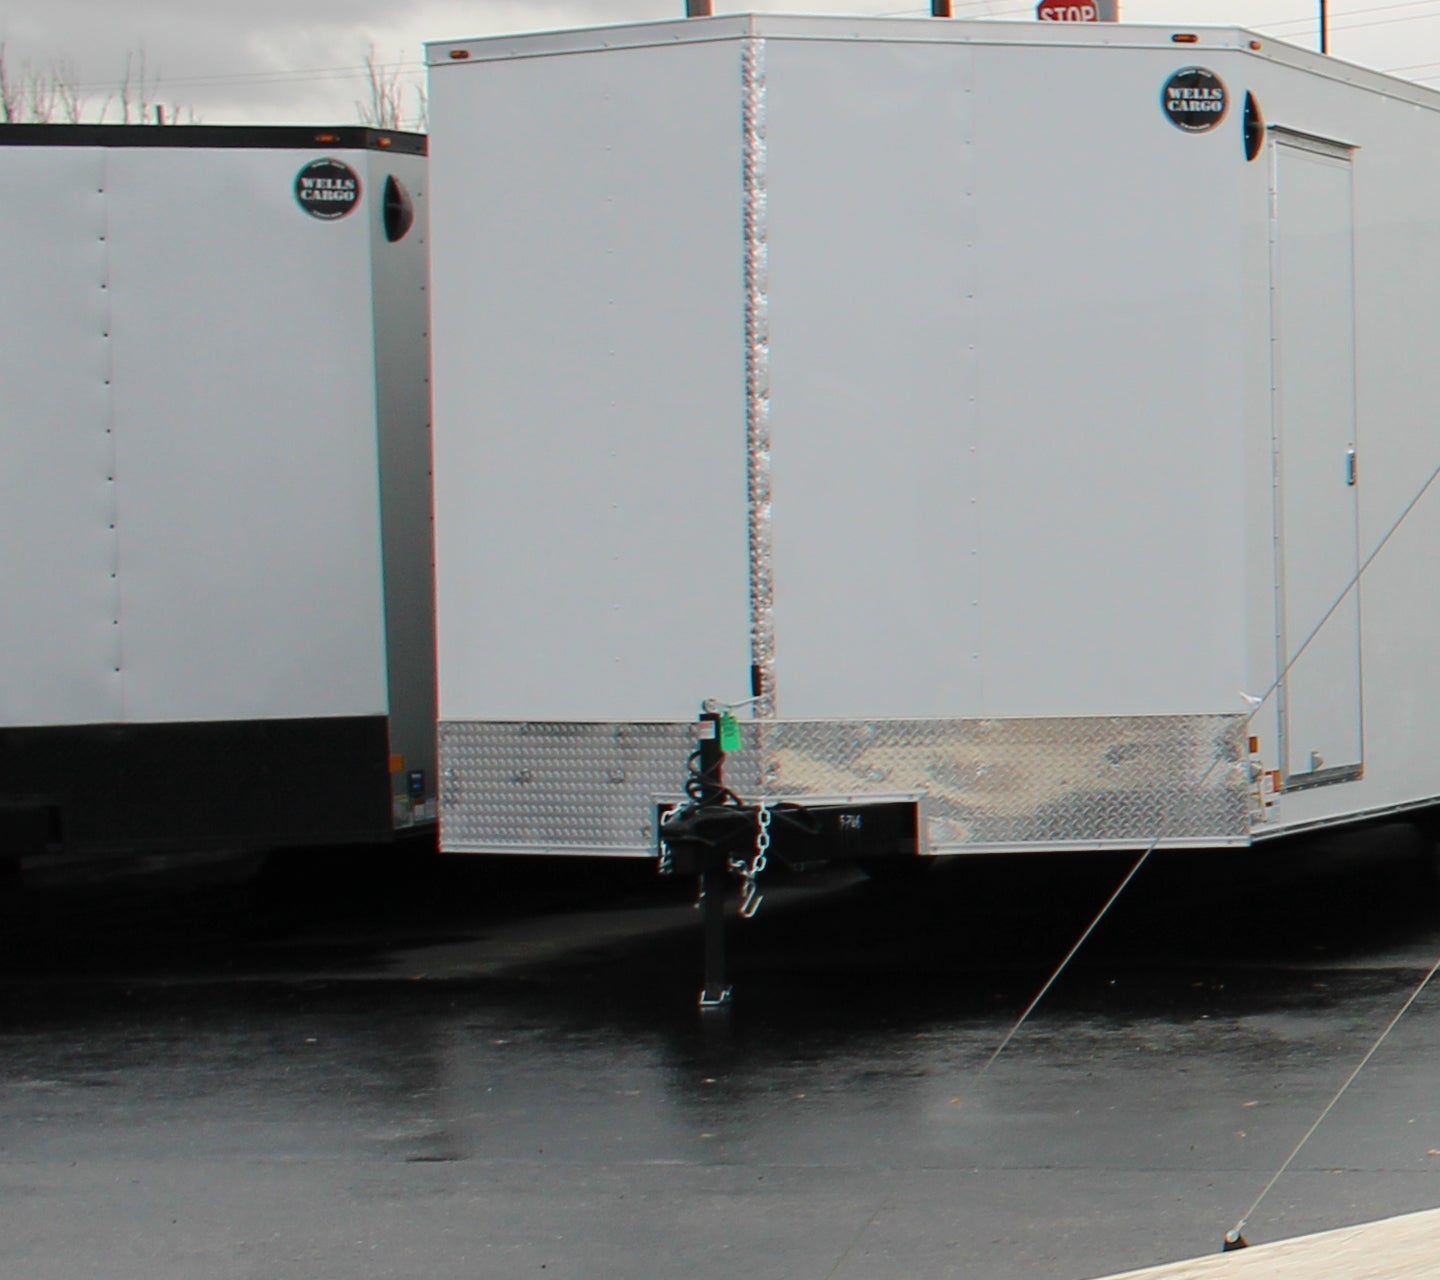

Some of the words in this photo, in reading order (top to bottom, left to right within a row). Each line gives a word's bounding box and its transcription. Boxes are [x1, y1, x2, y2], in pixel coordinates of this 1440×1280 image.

[1041, 5, 1095, 21] STOP
[1167, 87, 1223, 100] WELLS
[1167, 100, 1223, 112] CARGO
[300, 178, 356, 190] WELLS
[300, 189, 356, 201] CARGO
